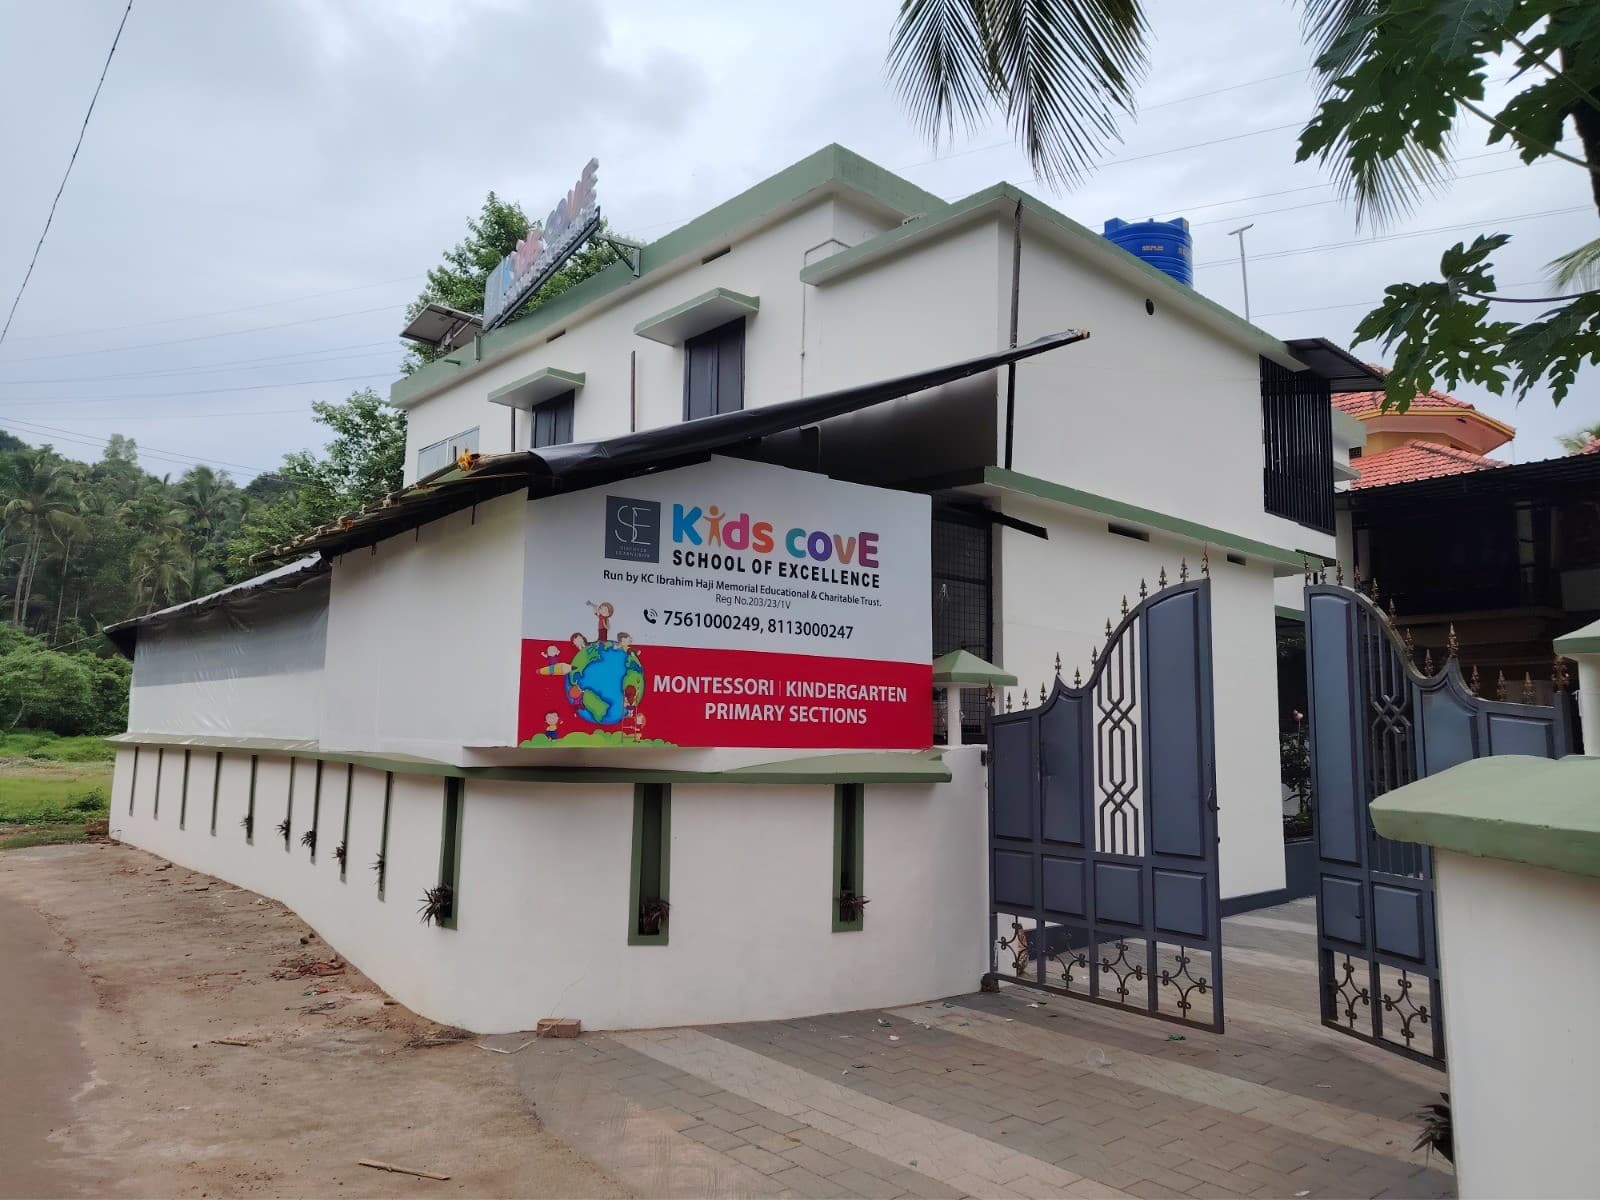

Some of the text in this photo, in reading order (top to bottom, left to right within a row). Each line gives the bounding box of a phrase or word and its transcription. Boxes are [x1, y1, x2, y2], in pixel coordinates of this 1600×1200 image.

[672, 503, 775, 554] Kids
[672, 549, 745, 573] SCHOOL
[751, 558, 773, 575] OF
[778, 561, 880, 589] EXCELLENCE
[603, 569, 882, 607] Run by KC Ibrahim Haji Memorial Educational & Charitable Trust.
[715, 593, 732, 606] Reg
[663, 610, 854, 640] 7561000249, 8113000247
[653, 674, 908, 703] MONTESSORI KINDERGARTEN
[704, 702, 868, 725] PRIMARY SECTIONS
